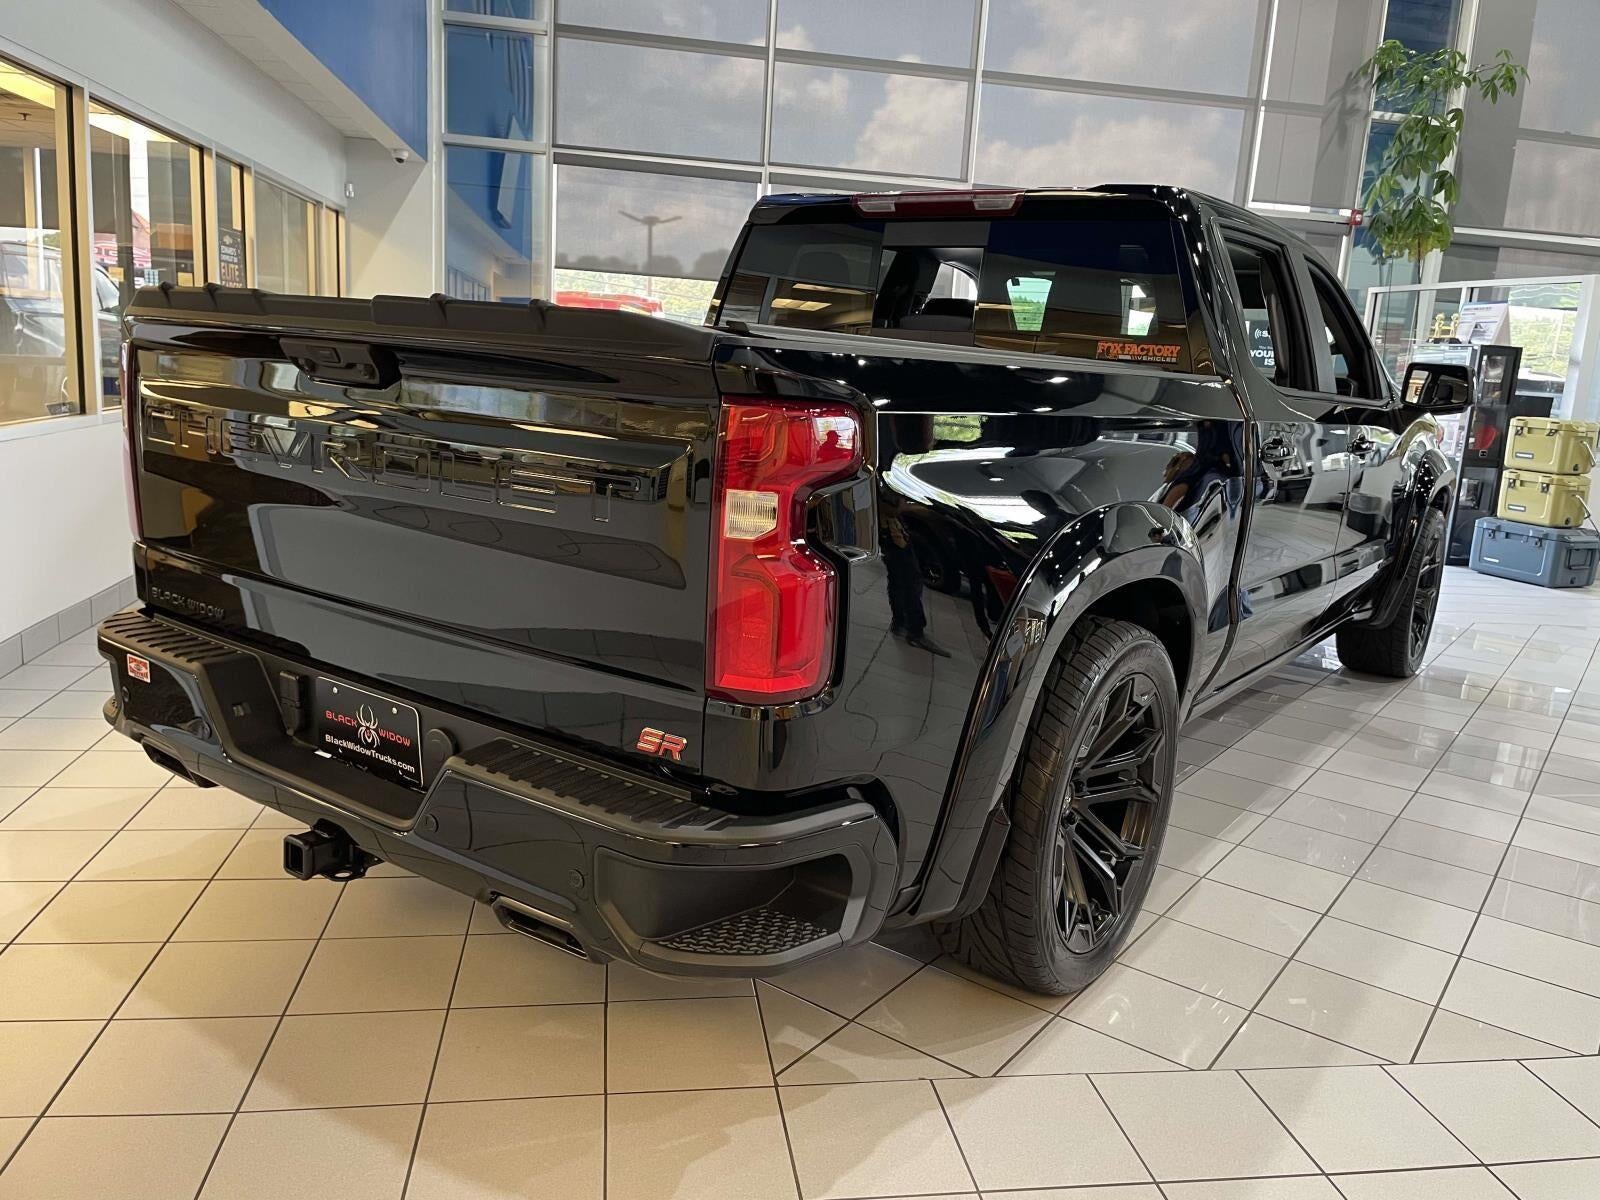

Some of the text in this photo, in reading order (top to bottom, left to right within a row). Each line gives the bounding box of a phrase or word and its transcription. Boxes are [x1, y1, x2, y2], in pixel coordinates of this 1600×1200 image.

[221, 262, 239, 281] ELITE
[1097, 341, 1181, 357] FOX FACTORY
[1138, 355, 1177, 363] VEHICLES
[145, 402, 642, 523] CHEVROLET
[151, 586, 226, 619] BLACK WIDOW
[325, 710, 411, 747] BLACK WIDOW
[637, 727, 687, 760] SR
[325, 733, 416, 774] BlackWidowTrucks.com
